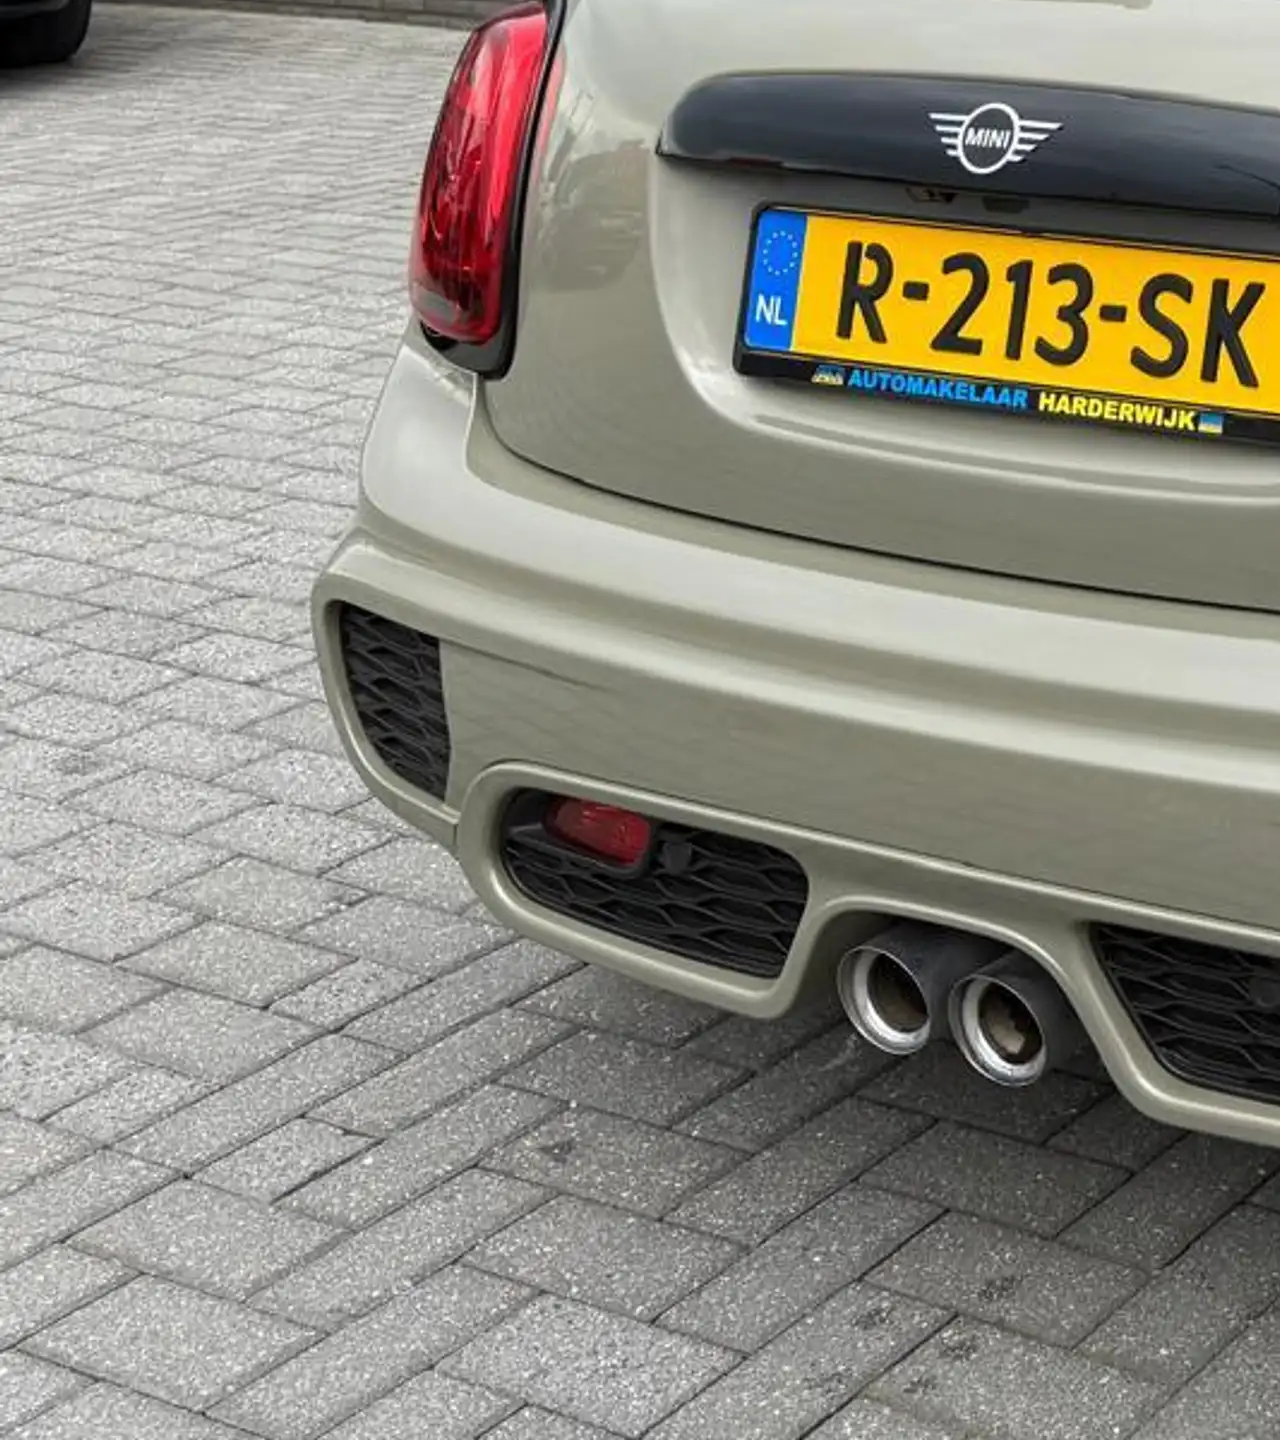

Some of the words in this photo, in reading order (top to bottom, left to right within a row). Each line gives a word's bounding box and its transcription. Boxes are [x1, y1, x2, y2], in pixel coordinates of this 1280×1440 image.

[965, 127, 1011, 149] MINI
[756, 294, 788, 326] NL
[836, 241, 1266, 388] R-213-SK
[847, 369, 1029, 408] AUTOMAKELAAR
[1038, 391, 1197, 432] HARDERWIJK
